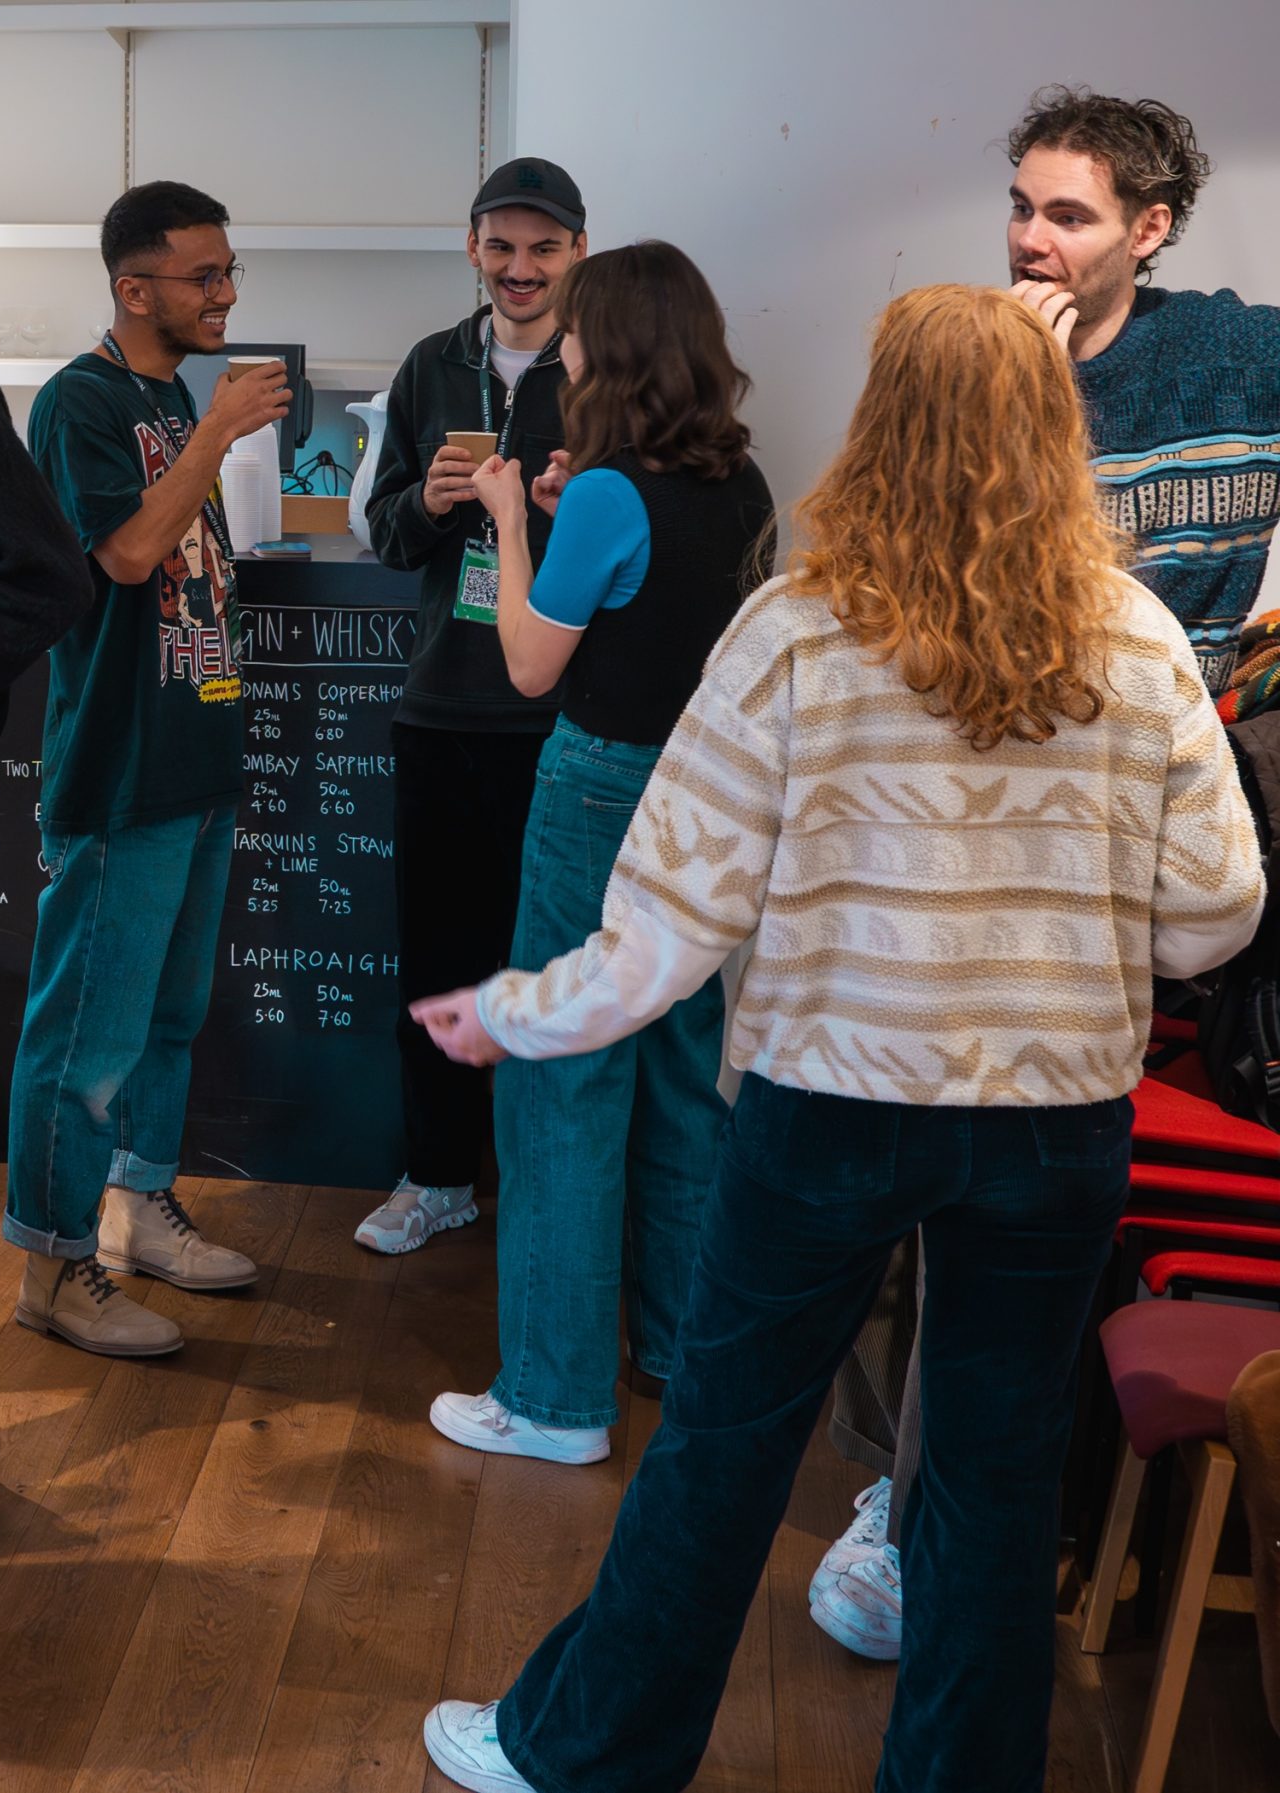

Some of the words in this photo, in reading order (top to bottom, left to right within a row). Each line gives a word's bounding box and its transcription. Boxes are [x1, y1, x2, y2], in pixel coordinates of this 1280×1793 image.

[204, 501, 217, 526] ORWICH
[242, 681, 302, 702] DNAMS
[1, 760, 29, 778] TWO
[242, 753, 300, 777] OMBAY
[233, 828, 317, 855] TARQUINS
[281, 857, 319, 873] LIME
[230, 943, 400, 976] LAPHROAIGH
